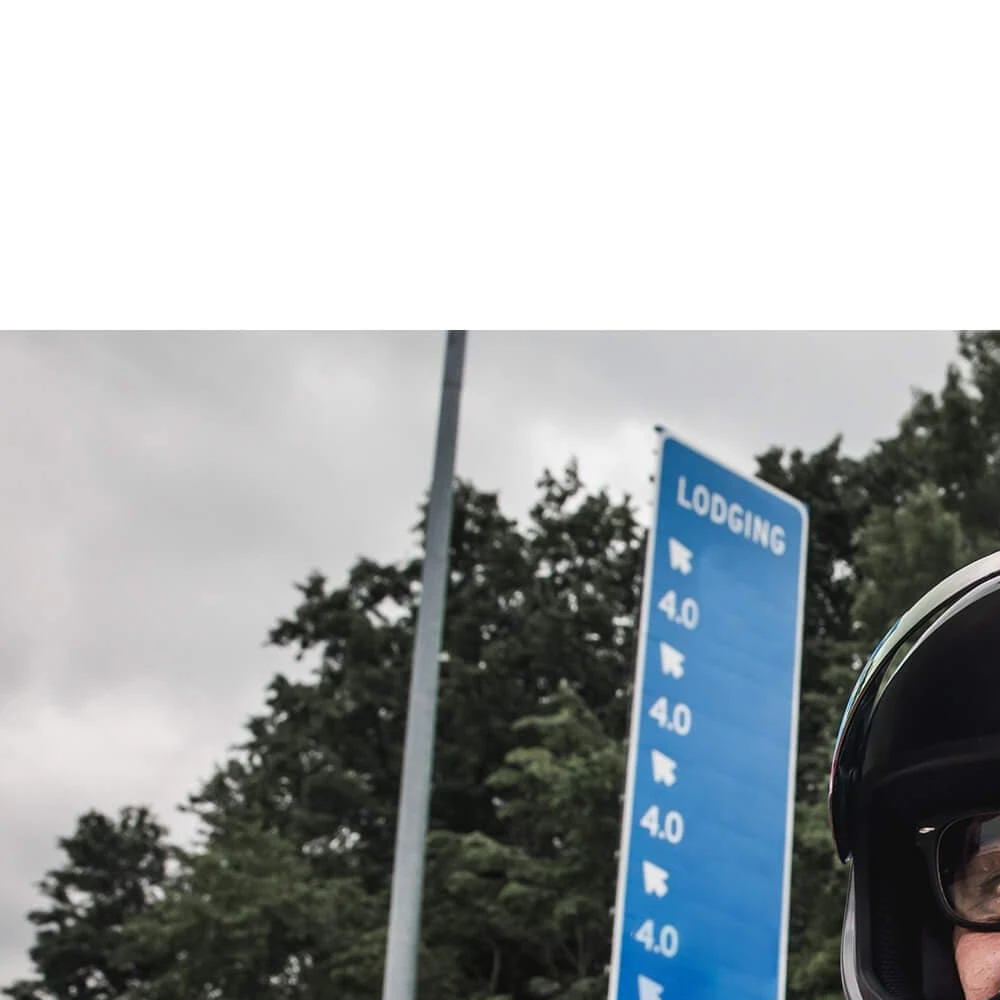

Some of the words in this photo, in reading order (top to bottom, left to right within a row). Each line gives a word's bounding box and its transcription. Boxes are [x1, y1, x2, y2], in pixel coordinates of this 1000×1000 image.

[676, 475, 786, 556] LODGING
[658, 589, 699, 629] 4.0
[648, 696, 692, 736] 4.0
[640, 805, 684, 844] 4.0
[635, 919, 679, 957] 4.0
